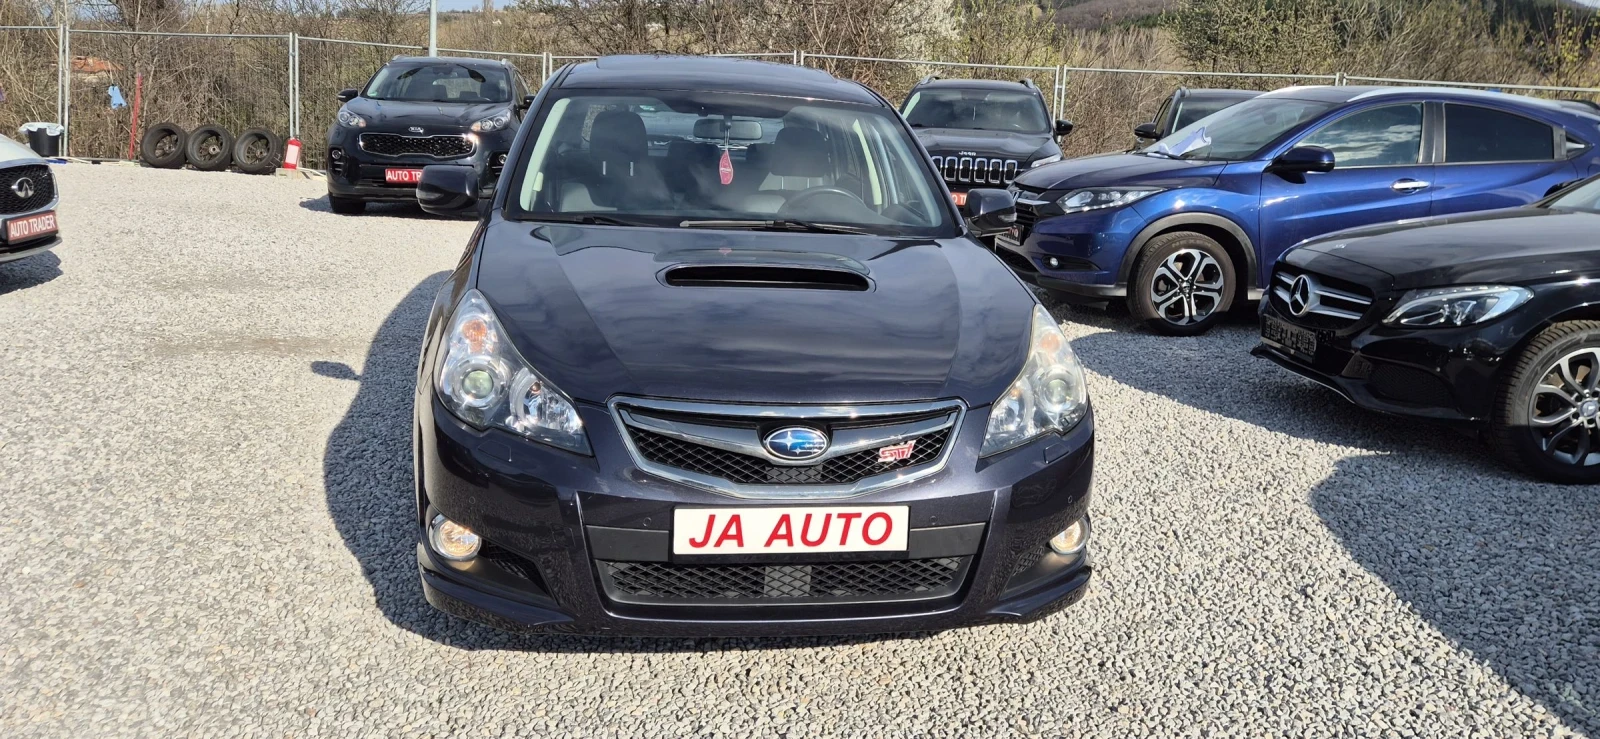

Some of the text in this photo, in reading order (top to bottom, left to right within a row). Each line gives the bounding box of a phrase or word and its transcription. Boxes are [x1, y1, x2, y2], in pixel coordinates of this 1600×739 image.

[386, 170, 422, 181] AUTO TR
[10, 215, 55, 237] AUTO TRADER
[688, 511, 893, 548] JA AUTO
